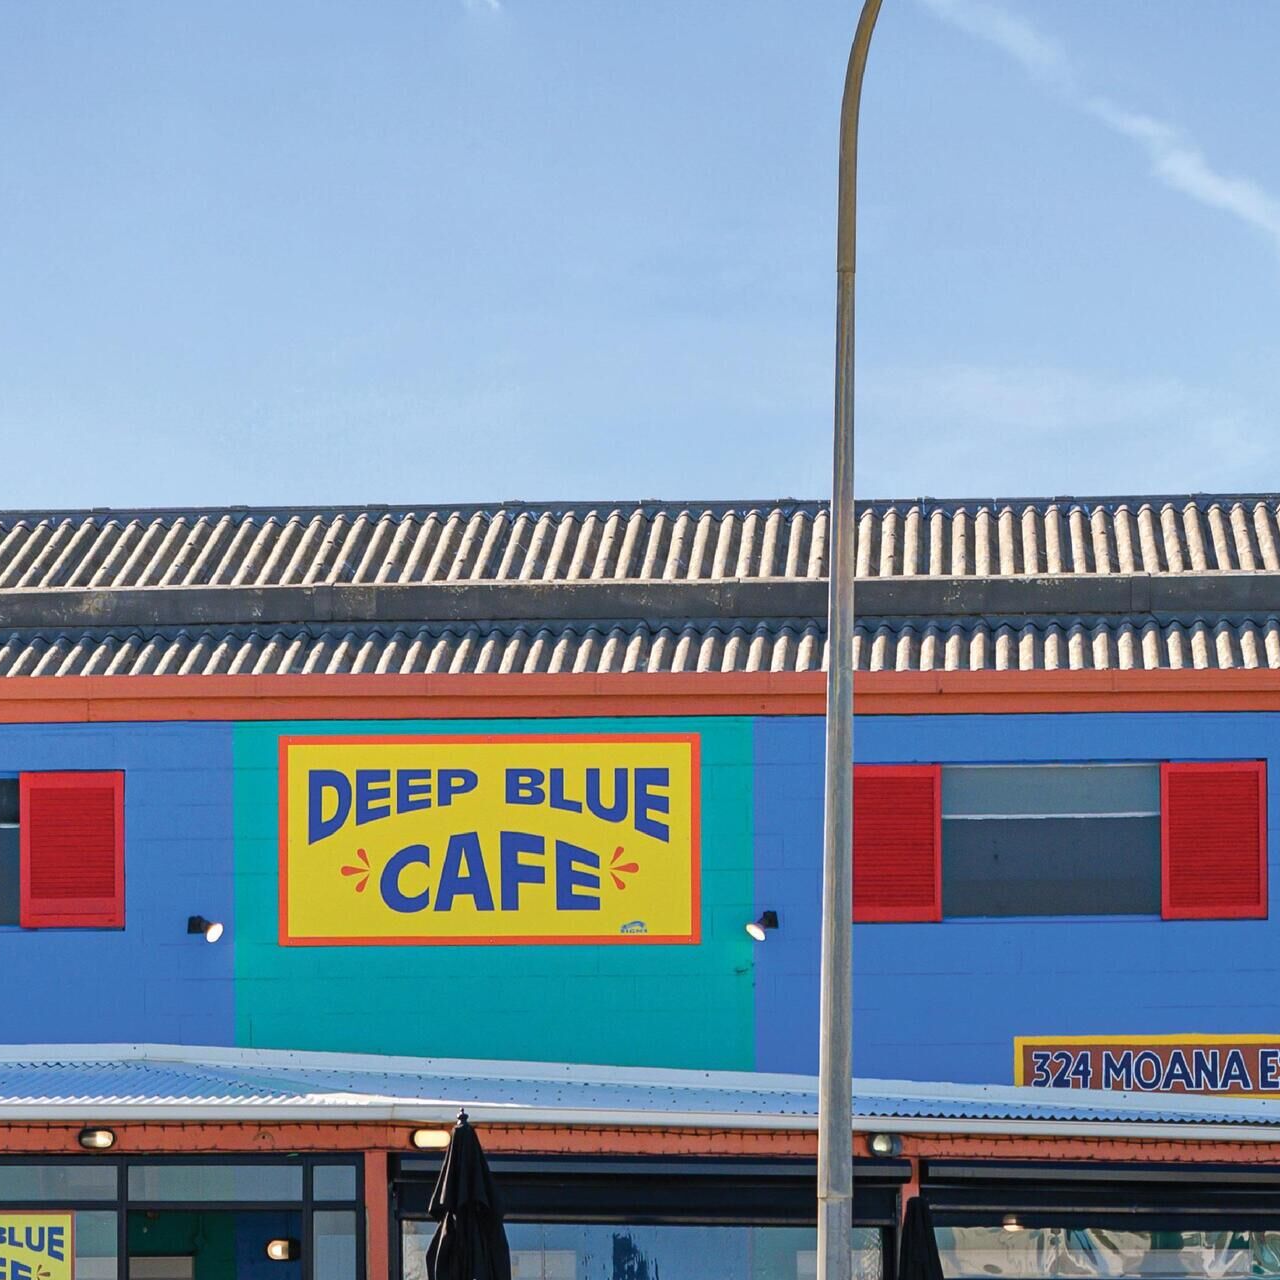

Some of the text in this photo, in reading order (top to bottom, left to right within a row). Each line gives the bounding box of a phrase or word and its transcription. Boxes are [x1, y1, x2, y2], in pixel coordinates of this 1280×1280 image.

[308, 767, 670, 845] DEEP BLUE
[379, 831, 601, 914] CAFE
[1032, 1051, 1092, 1089] 324
[1102, 1050, 1252, 1090] MOANA
